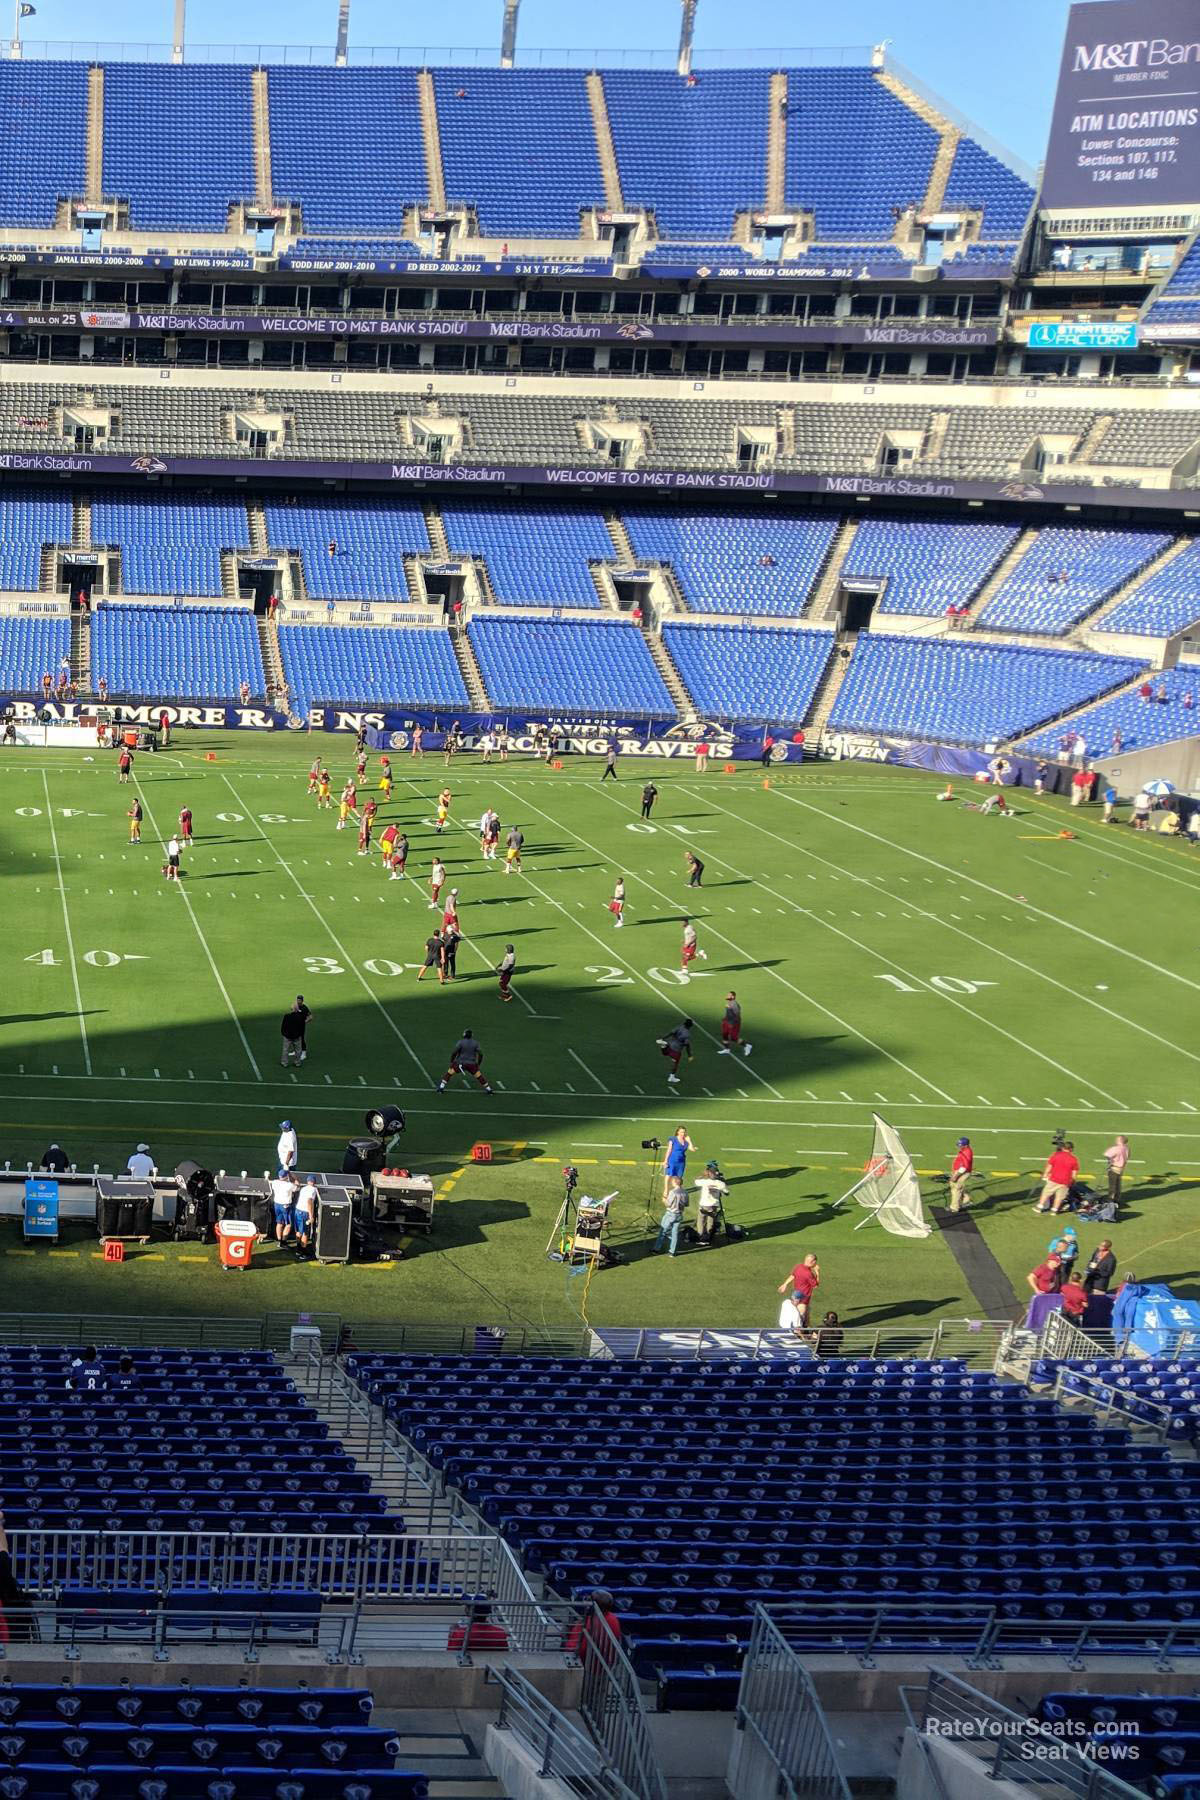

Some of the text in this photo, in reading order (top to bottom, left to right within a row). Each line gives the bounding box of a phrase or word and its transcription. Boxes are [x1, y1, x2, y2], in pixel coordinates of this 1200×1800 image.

[1071, 39, 1200, 72] M&T Ban
[1113, 70, 1169, 82] MEMBER FDIC
[1070, 108, 1198, 132] ATM LOCATIONS
[1081, 136, 1180, 151] Lower Concourse:
[1077, 151, 1177, 167] Sections 107, 117,
[1092, 167, 1158, 182] 134 and 146
[54, 256, 143, 266] JAMAL LEWIS 2000-2006
[174, 258, 249, 268] RAY LEWIS 1996-2012
[291, 260, 375, 271] TODD HEAP 2001-2010
[407, 263, 481, 272] ED REED 2002-2012
[515, 264, 559, 274] SMYTH
[718, 268, 852, 277] 2000 WORLD CHAMPIONS 2012
[5, 312, 14, 324] 4
[28, 314, 77, 325] BALL ON 25
[139, 315, 244, 330] M&T Bank Stadium
[262, 318, 467, 335] WELCOME TO M&T BANK STADIU
[490, 323, 600, 339] M&T Bank Stadium
[864, 328, 987, 344] M&T Bank Stadium
[1055, 335, 1130, 345] FACTORY
[13, 455, 42, 469] Bank
[44, 456, 91, 470] Stadium
[391, 465, 505, 481] M&T Bank Stadium
[546, 469, 773, 489] WELCOME TO M&T BANK STADIU
[826, 477, 954, 496] M&T Bank Stadium
[24, 948, 121, 967] 40
[303, 957, 403, 976] 30
[584, 965, 692, 985] 20
[874, 973, 978, 994] 10
[477, 1145, 491, 1160] 30
[107, 1245, 122, 1259] 40
[229, 1240, 246, 1258] G
